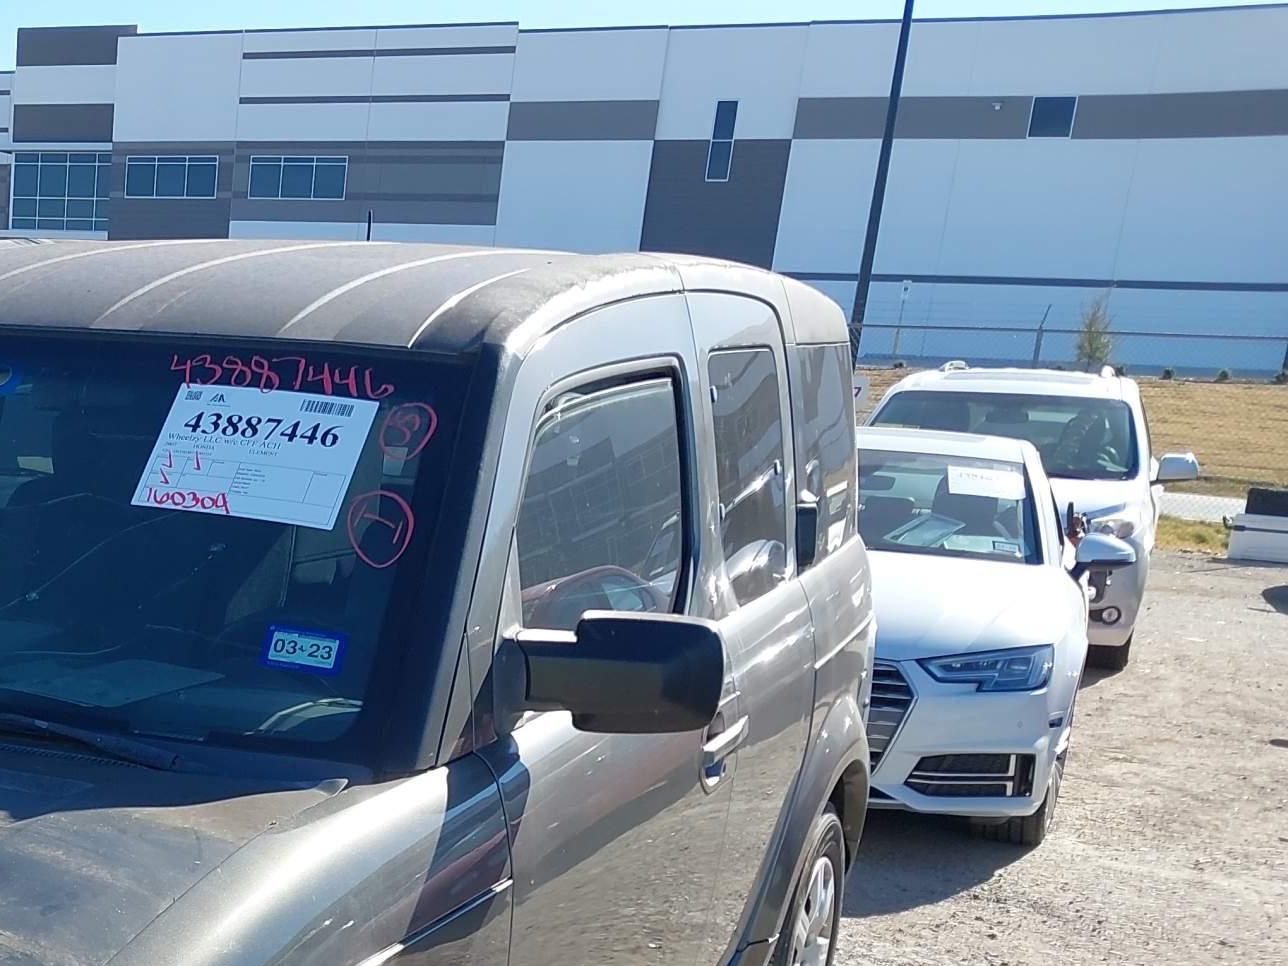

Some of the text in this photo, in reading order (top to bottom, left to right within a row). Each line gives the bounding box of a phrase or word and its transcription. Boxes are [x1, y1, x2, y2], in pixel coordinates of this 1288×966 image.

[170, 354, 394, 399] 43887446
[183, 411, 344, 448] 43887446
[273, 638, 333, 660] 03 23
